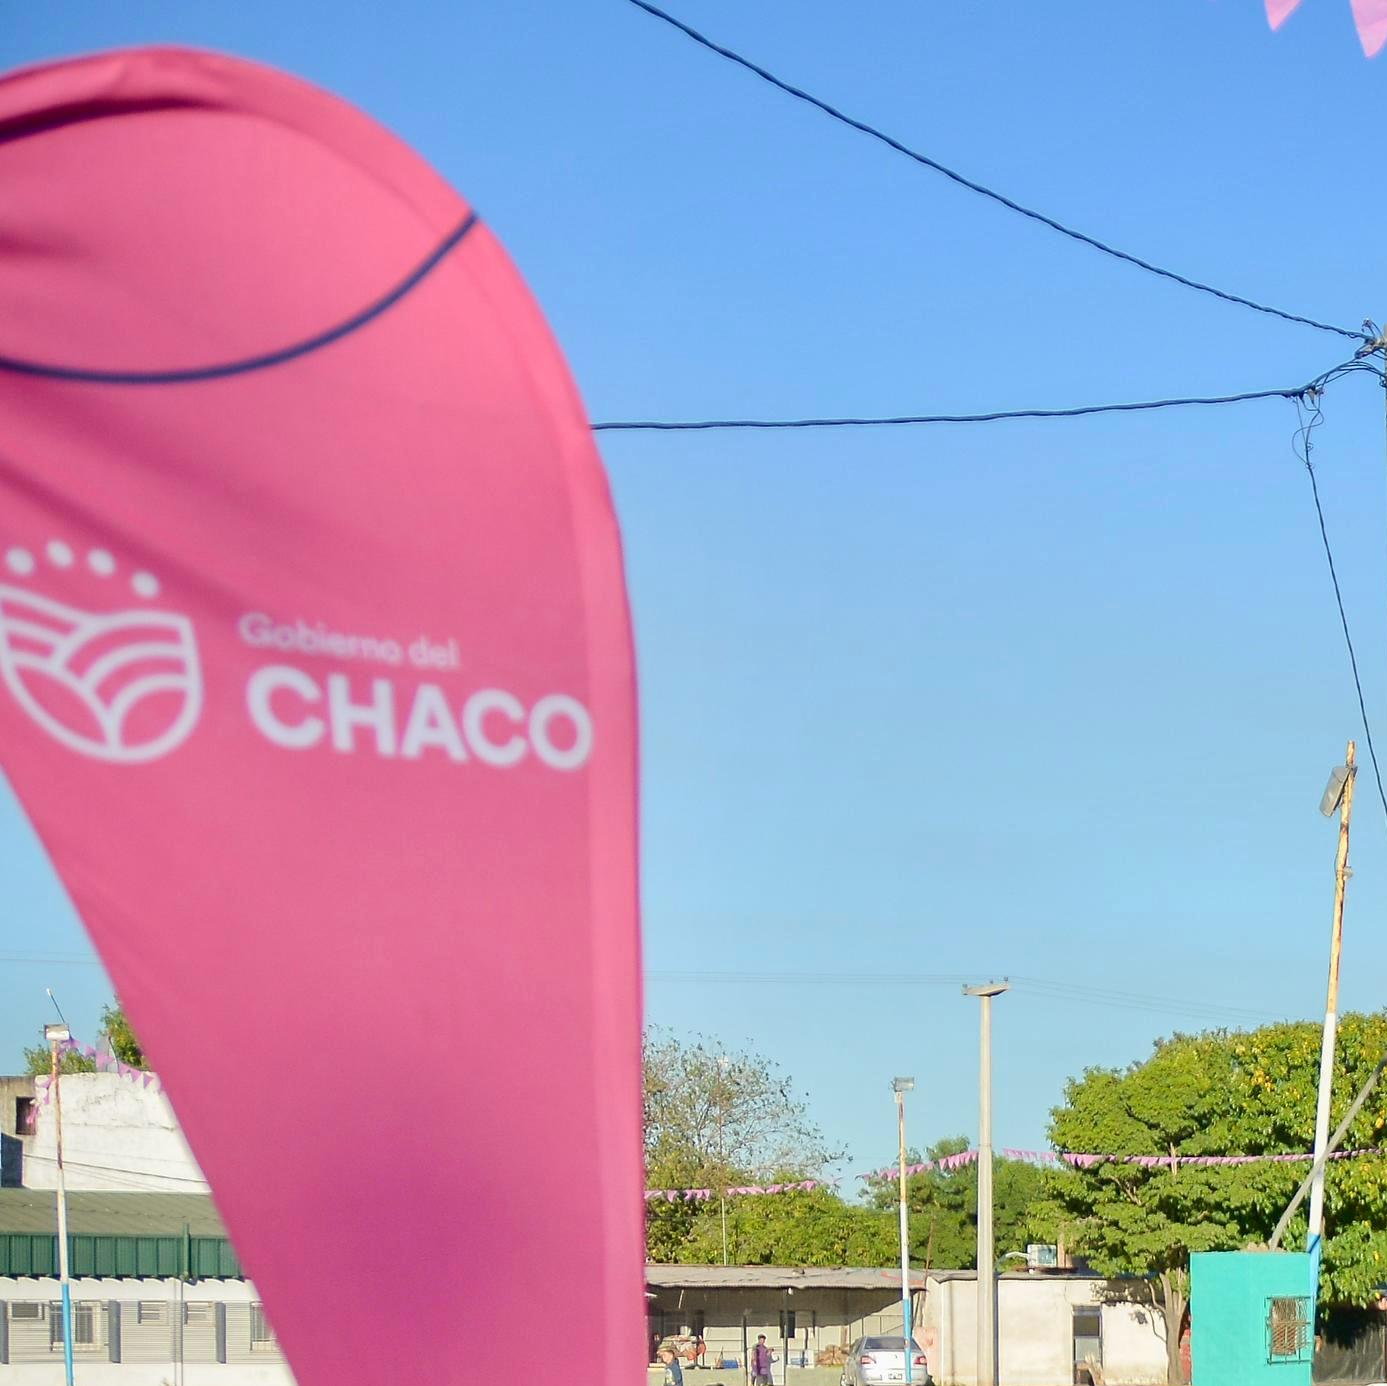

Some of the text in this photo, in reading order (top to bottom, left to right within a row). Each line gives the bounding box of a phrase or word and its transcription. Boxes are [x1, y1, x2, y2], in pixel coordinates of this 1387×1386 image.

[238, 612, 459, 669] Gobierno del
[246, 665, 593, 770] CHACO
